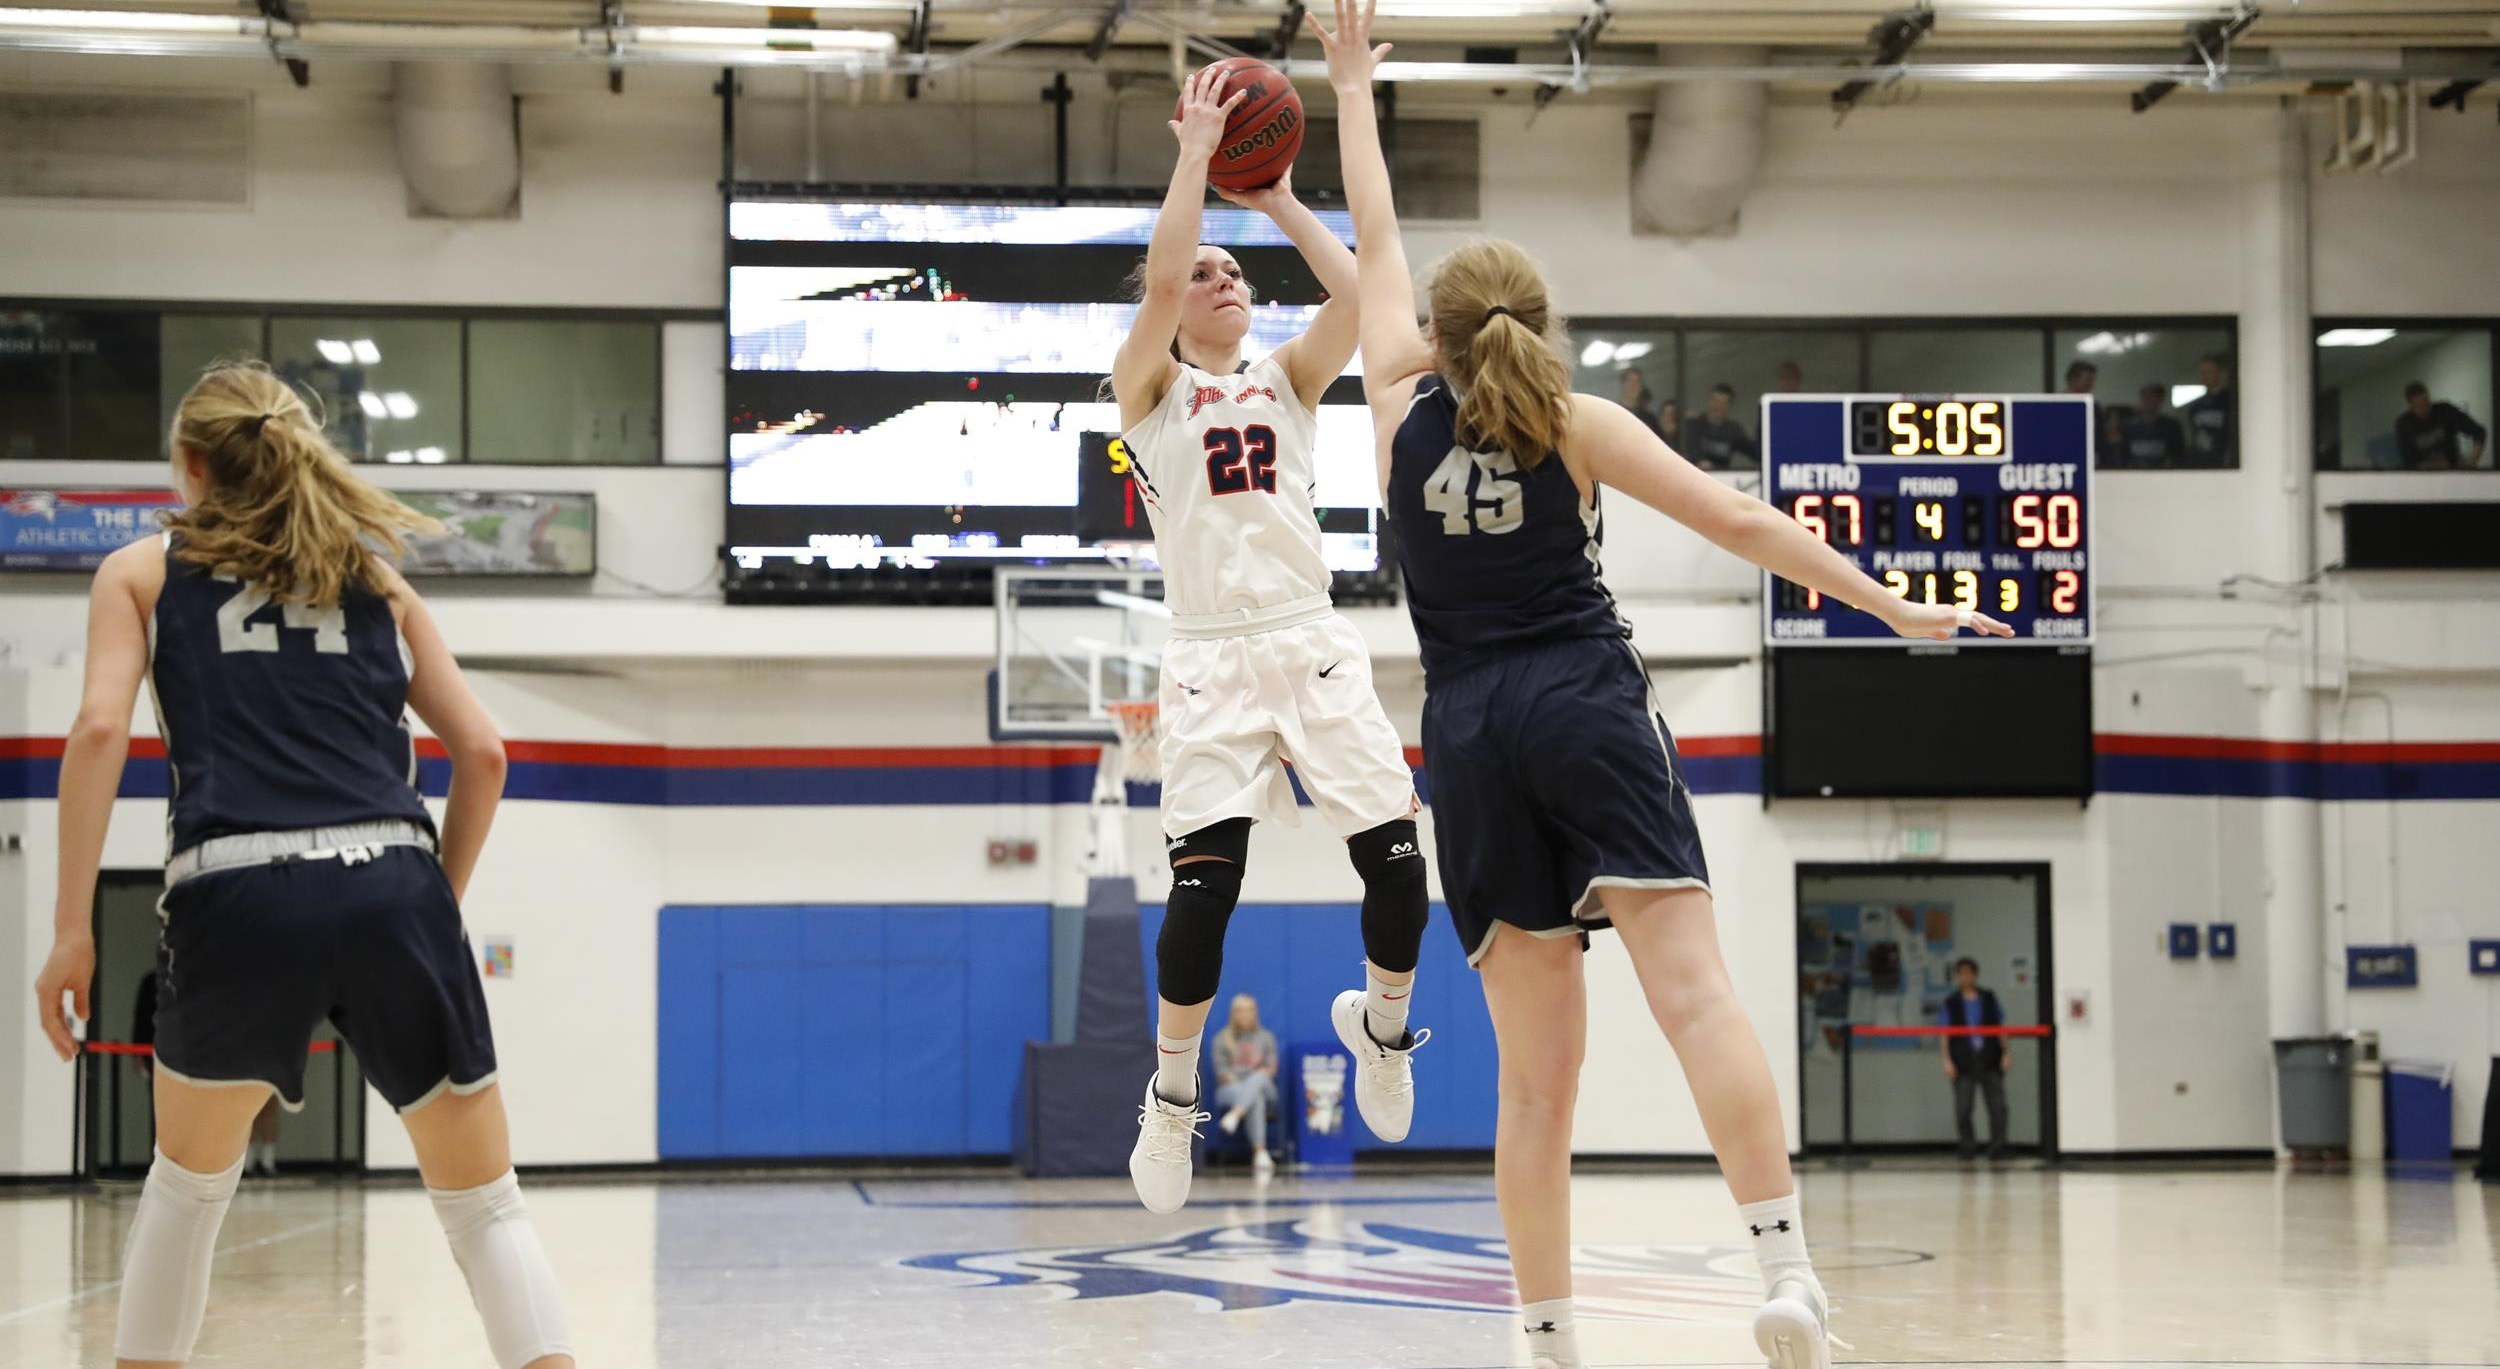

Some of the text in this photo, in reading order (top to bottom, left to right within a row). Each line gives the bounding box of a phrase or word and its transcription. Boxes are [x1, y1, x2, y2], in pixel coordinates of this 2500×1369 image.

[1221, 104, 1297, 162] Wilson
[1888, 401, 2002, 457] 5:05
[1203, 423, 1276, 496] 22
[1779, 463, 1861, 491] METRO
[1998, 463, 2078, 491] GUEST
[1423, 444, 1524, 536] 45
[1899, 476, 1958, 498] PERIOD
[93, 507, 134, 528] THE
[1915, 502, 1943, 541] 4
[2012, 494, 2079, 549] 50
[16, 528, 96, 547] ATHLETIC
[1873, 550, 1936, 572] PLAYER
[1942, 550, 1985, 571] FOUL
[2032, 550, 2085, 571] FOULS
[2000, 578, 2019, 612] 3
[2052, 570, 2079, 613] 2
[211, 570, 349, 655] 24
